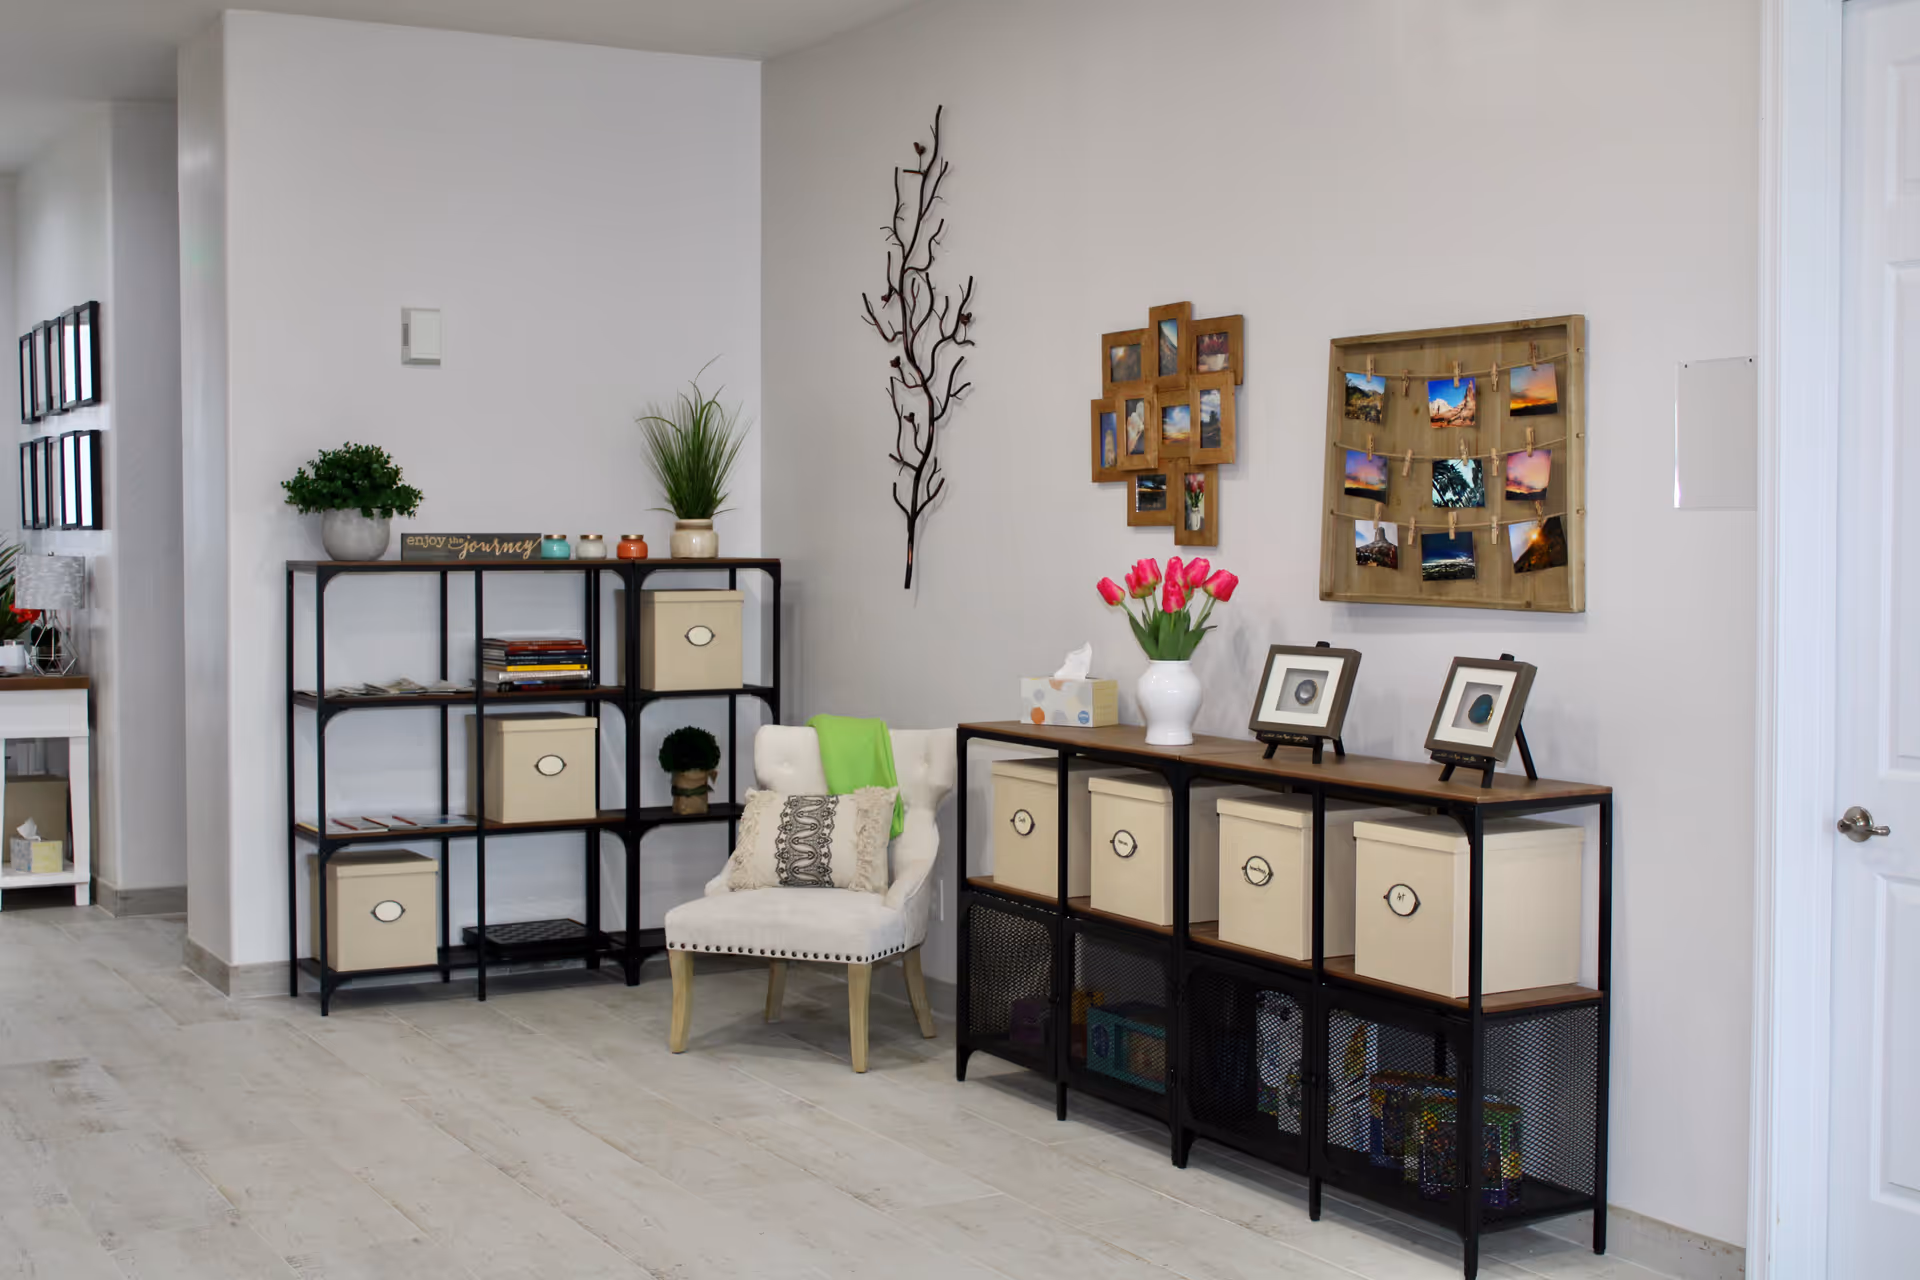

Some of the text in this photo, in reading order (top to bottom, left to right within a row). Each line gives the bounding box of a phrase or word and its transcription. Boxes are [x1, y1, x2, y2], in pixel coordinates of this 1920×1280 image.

[407, 535, 541, 559] enjoy the journey
